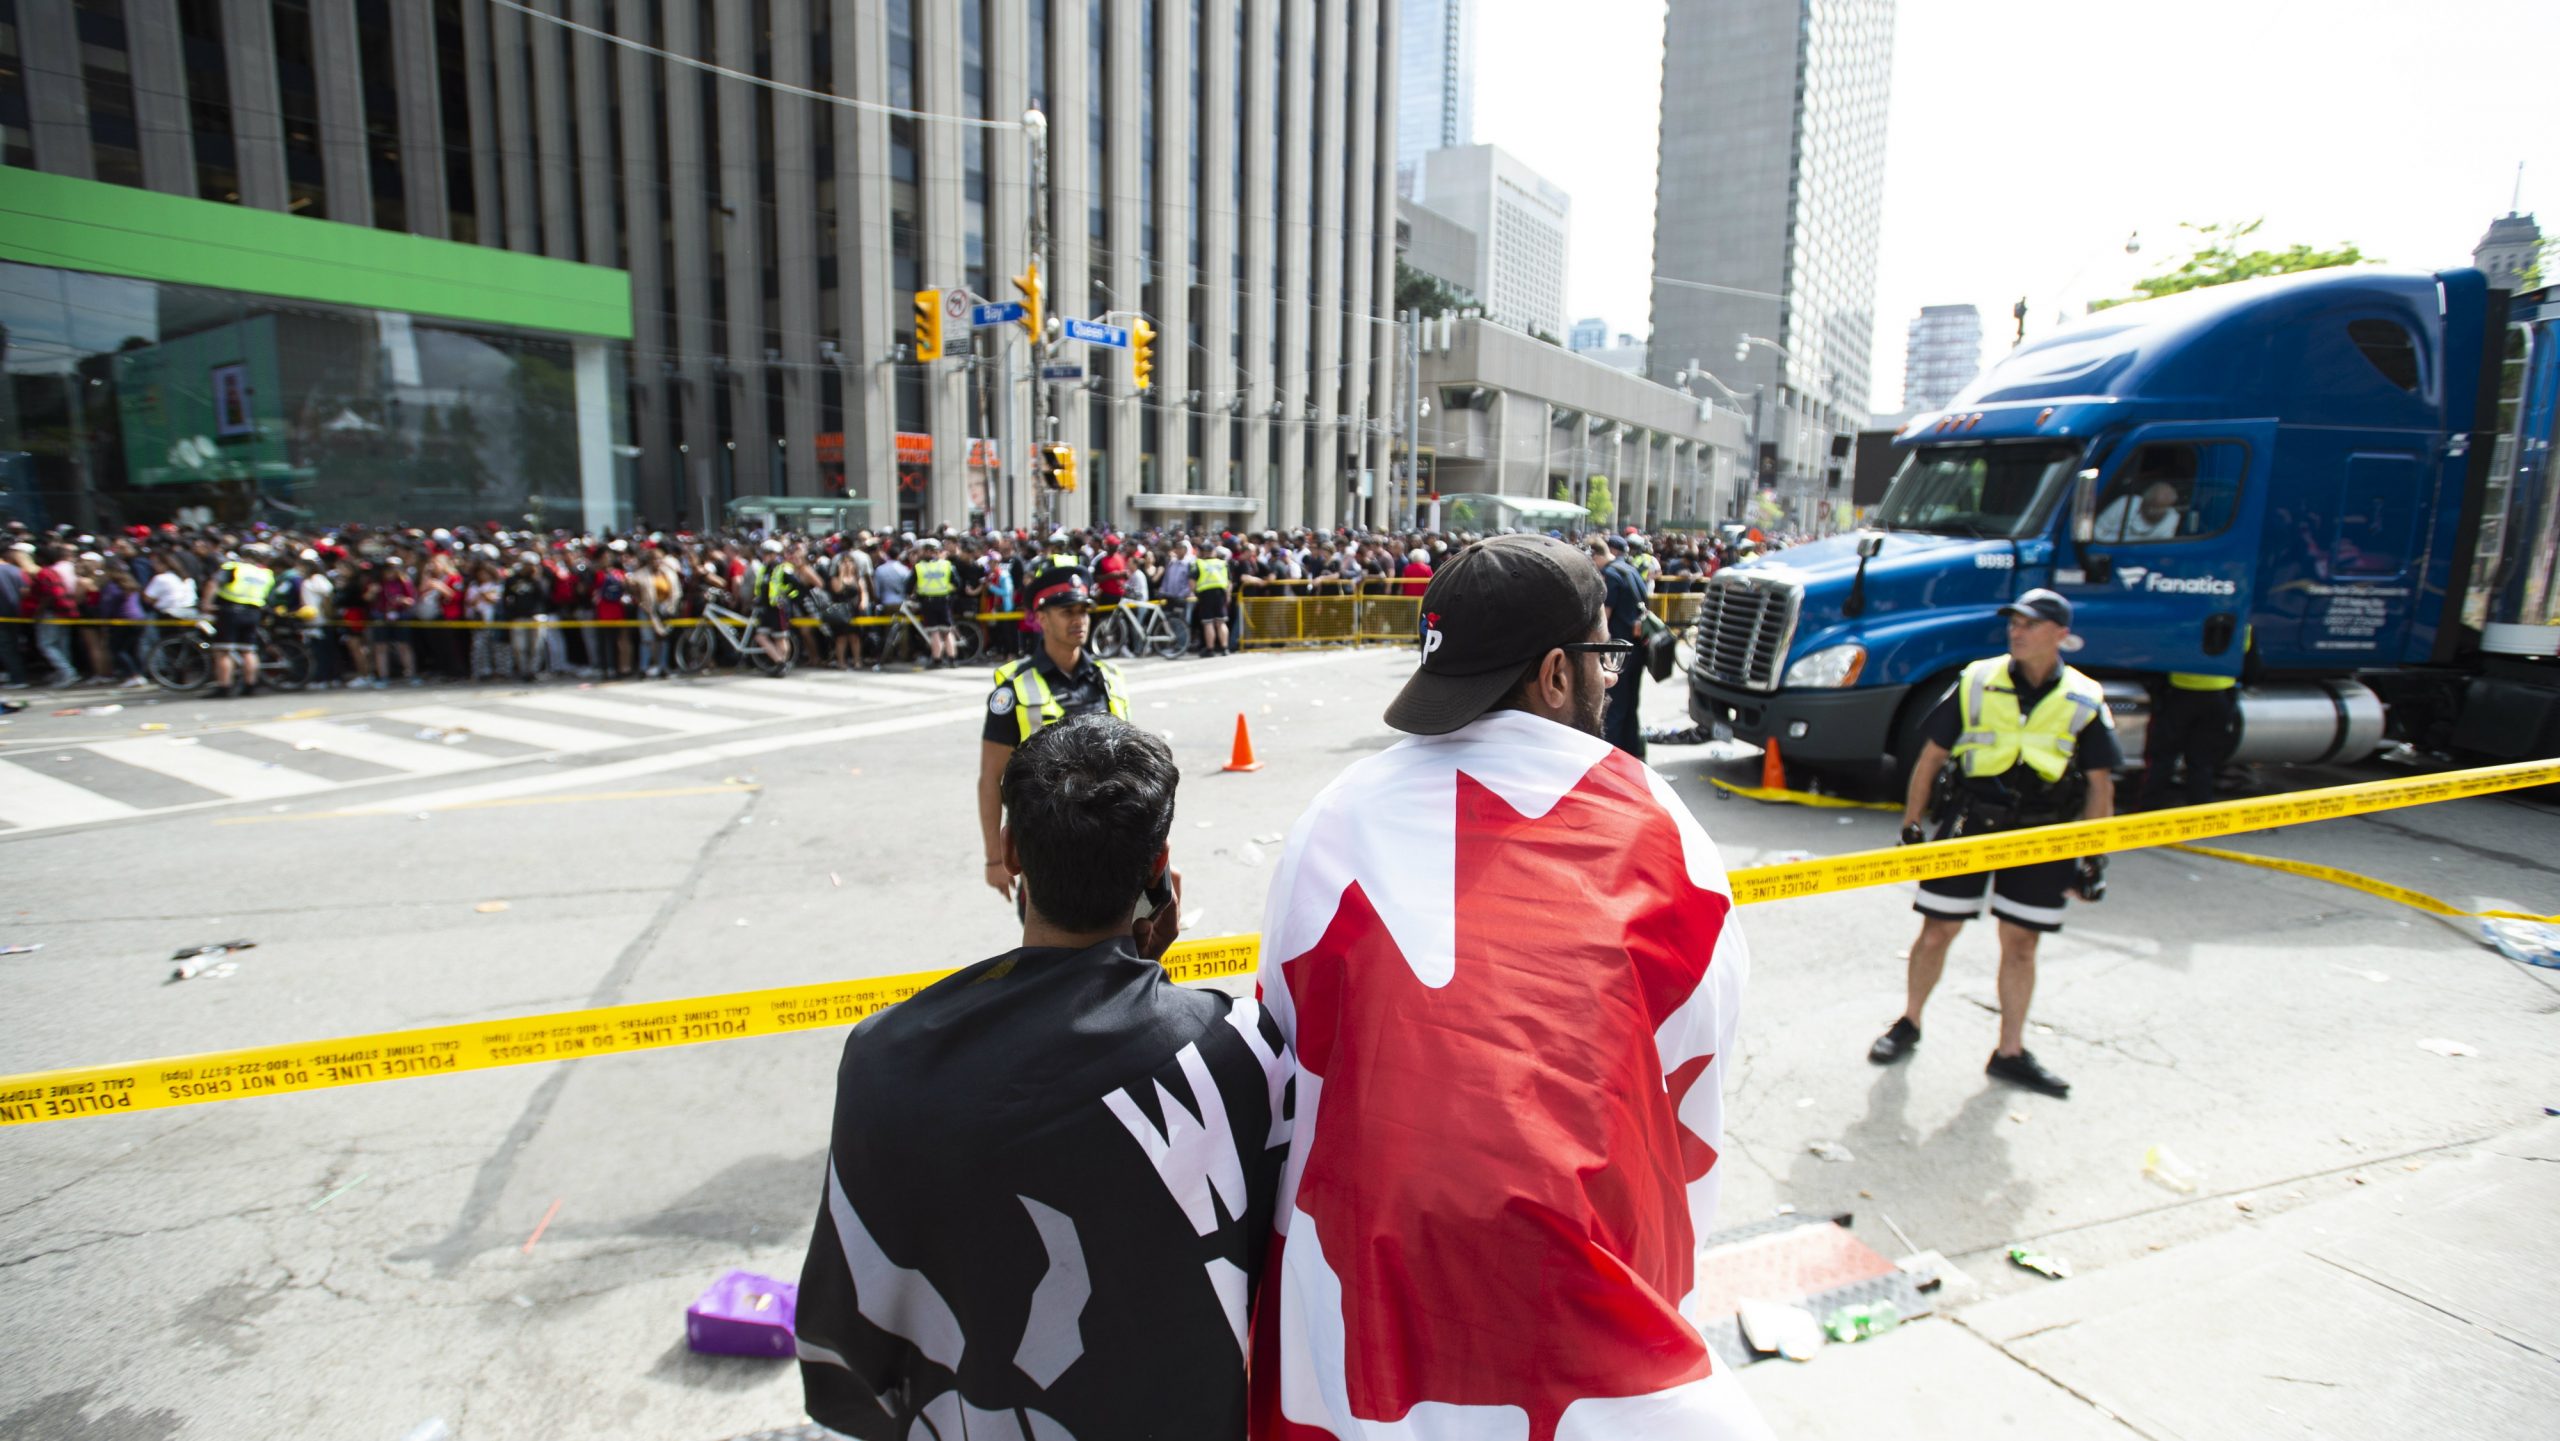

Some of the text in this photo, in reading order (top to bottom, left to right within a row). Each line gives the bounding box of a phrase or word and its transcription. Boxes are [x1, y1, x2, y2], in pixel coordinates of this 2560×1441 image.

[983, 305, 1004, 322] Bay
[1072, 320, 1104, 339] Queen
[2145, 571, 2237, 596] Fanatics
[1422, 629, 1443, 665] P
[1934, 857, 1970, 874] POLICE
[1780, 879, 1819, 895] POLICE
[1158, 946, 1252, 966] CALL CRIME STOPP
[1193, 958, 1248, 977] POLICE
[682, 1010, 720, 1023] CRIME
[723, 1005, 751, 1018] CALL
[776, 1008, 828, 1026] CROSS
[835, 1005, 863, 1019] NOT
[430, 1039, 461, 1052] CALL
[488, 1019, 747, 1061] POLICE LINE- DO NOT CROSS
[384, 1043, 425, 1058] CRIME
[101, 1077, 136, 1091] CALL
[159, 1067, 194, 1085] (tips)
[167, 1053, 456, 1099] POLICE LINE- DO NOT CROSS
[49, 1081, 96, 1099] CRIME
[45, 1092, 131, 1117] POLICE
